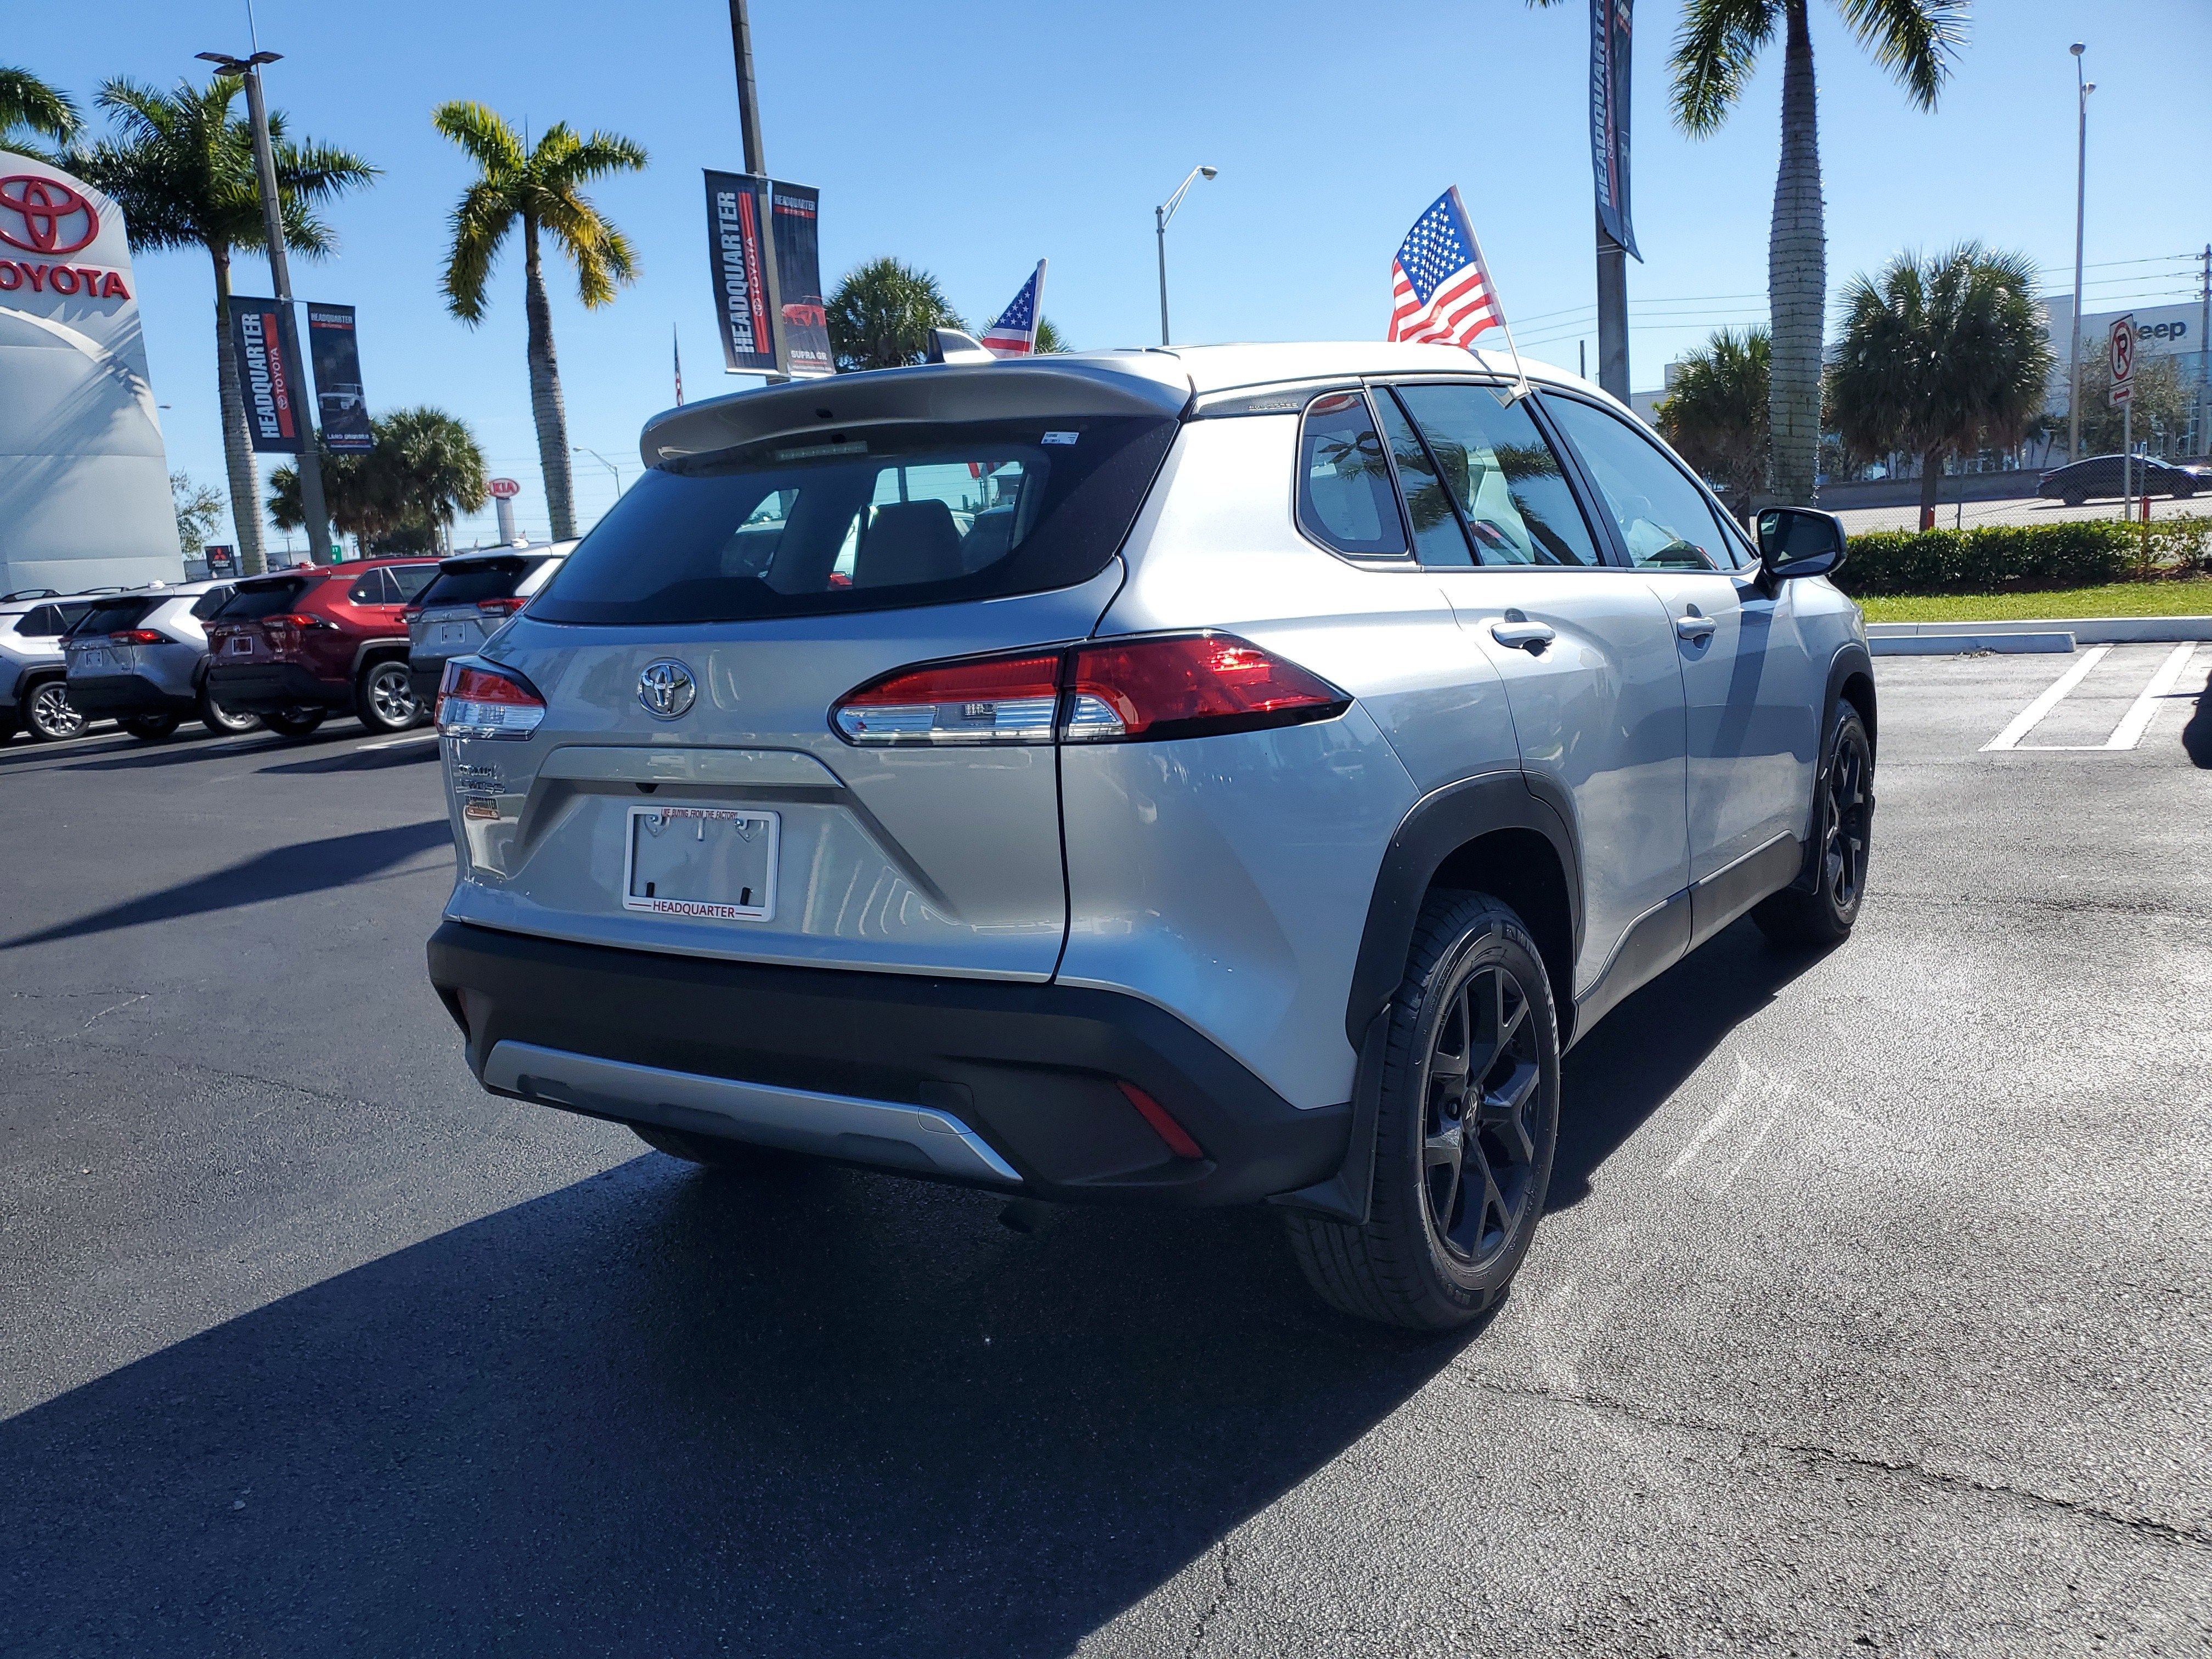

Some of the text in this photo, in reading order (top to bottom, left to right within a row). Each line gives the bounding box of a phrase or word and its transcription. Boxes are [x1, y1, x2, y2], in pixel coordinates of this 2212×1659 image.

[1595, 0, 1610, 207] HEADQUARTE
[716, 191, 754, 353] HEADQUARTER
[746, 237, 760, 295] TOYOTA
[2133, 320, 2186, 341] eep
[241, 313, 280, 438] HEADQUARTER
[270, 347, 285, 394] TOYOTA
[791, 350, 816, 359] SUPRA
[672, 809, 689, 817] BUYING
[691, 809, 703, 819] FROM
[706, 810, 714, 819] THE
[653, 900, 735, 918] HEADQUARTER
